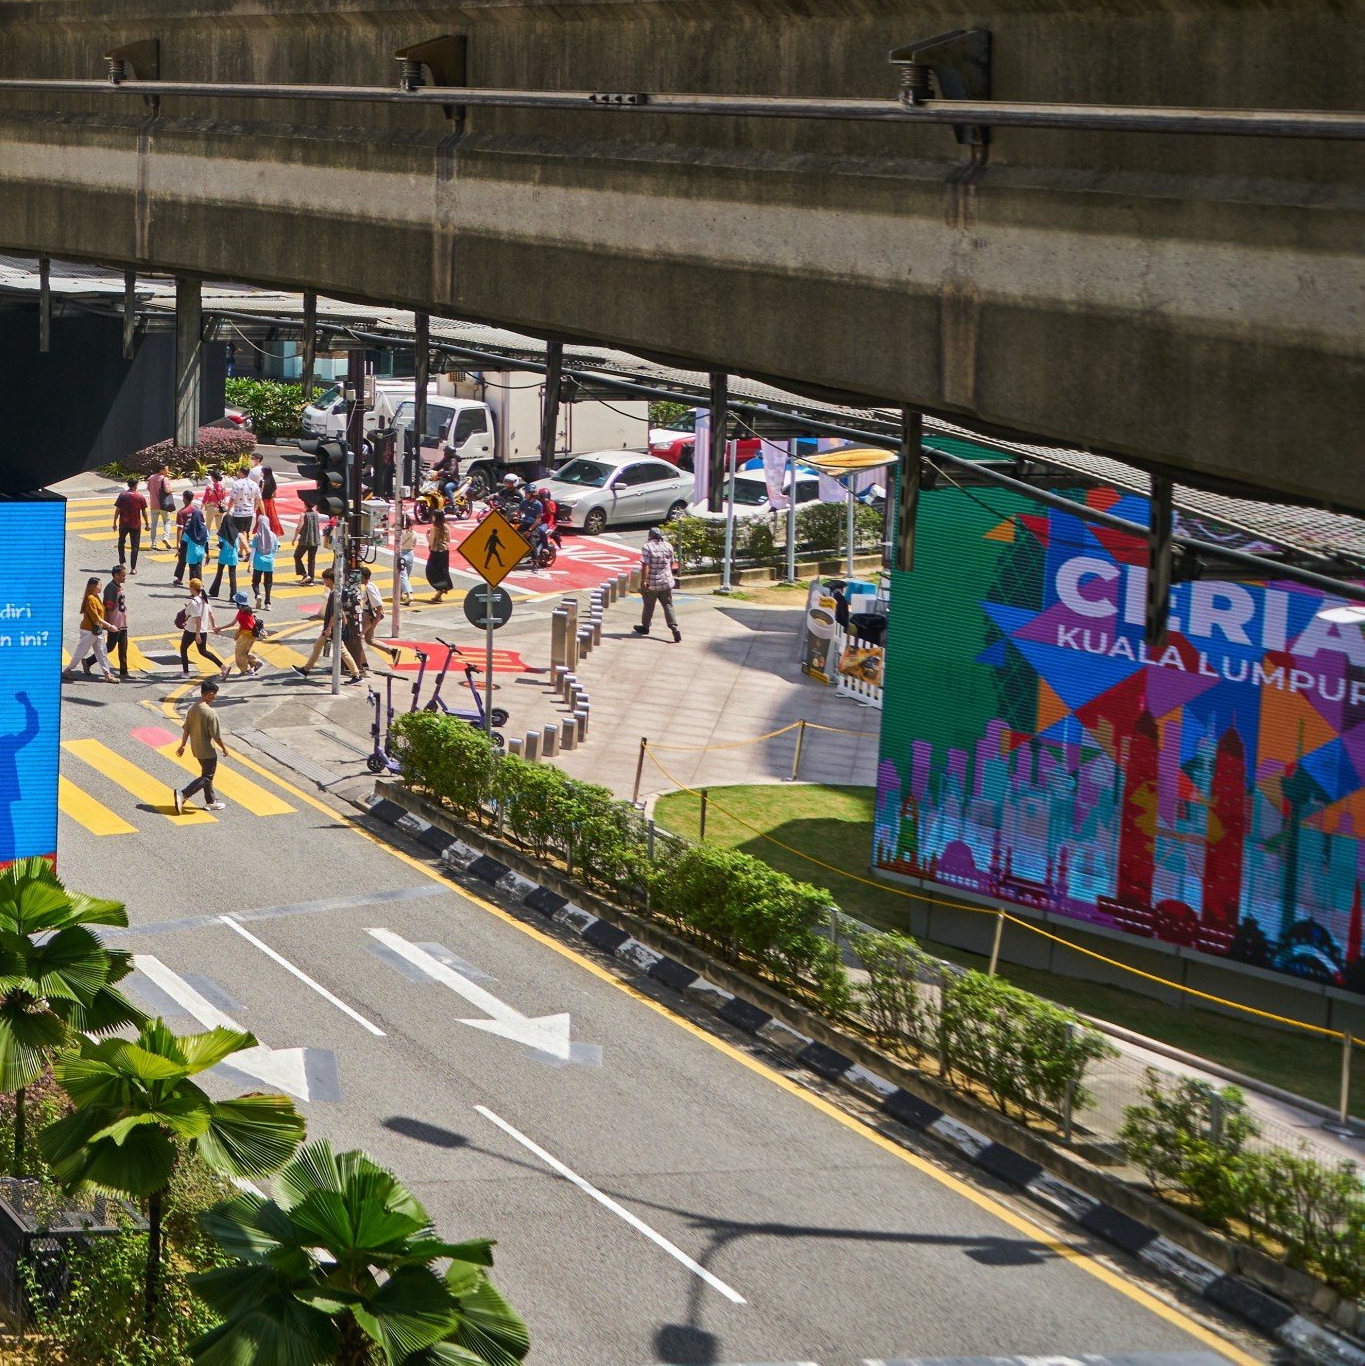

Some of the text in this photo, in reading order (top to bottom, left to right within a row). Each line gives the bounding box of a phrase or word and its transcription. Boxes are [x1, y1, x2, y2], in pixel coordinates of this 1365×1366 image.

[0, 603, 32, 620] diri
[20, 630, 49, 647] ini?
[1057, 624, 1187, 672] KUALA
